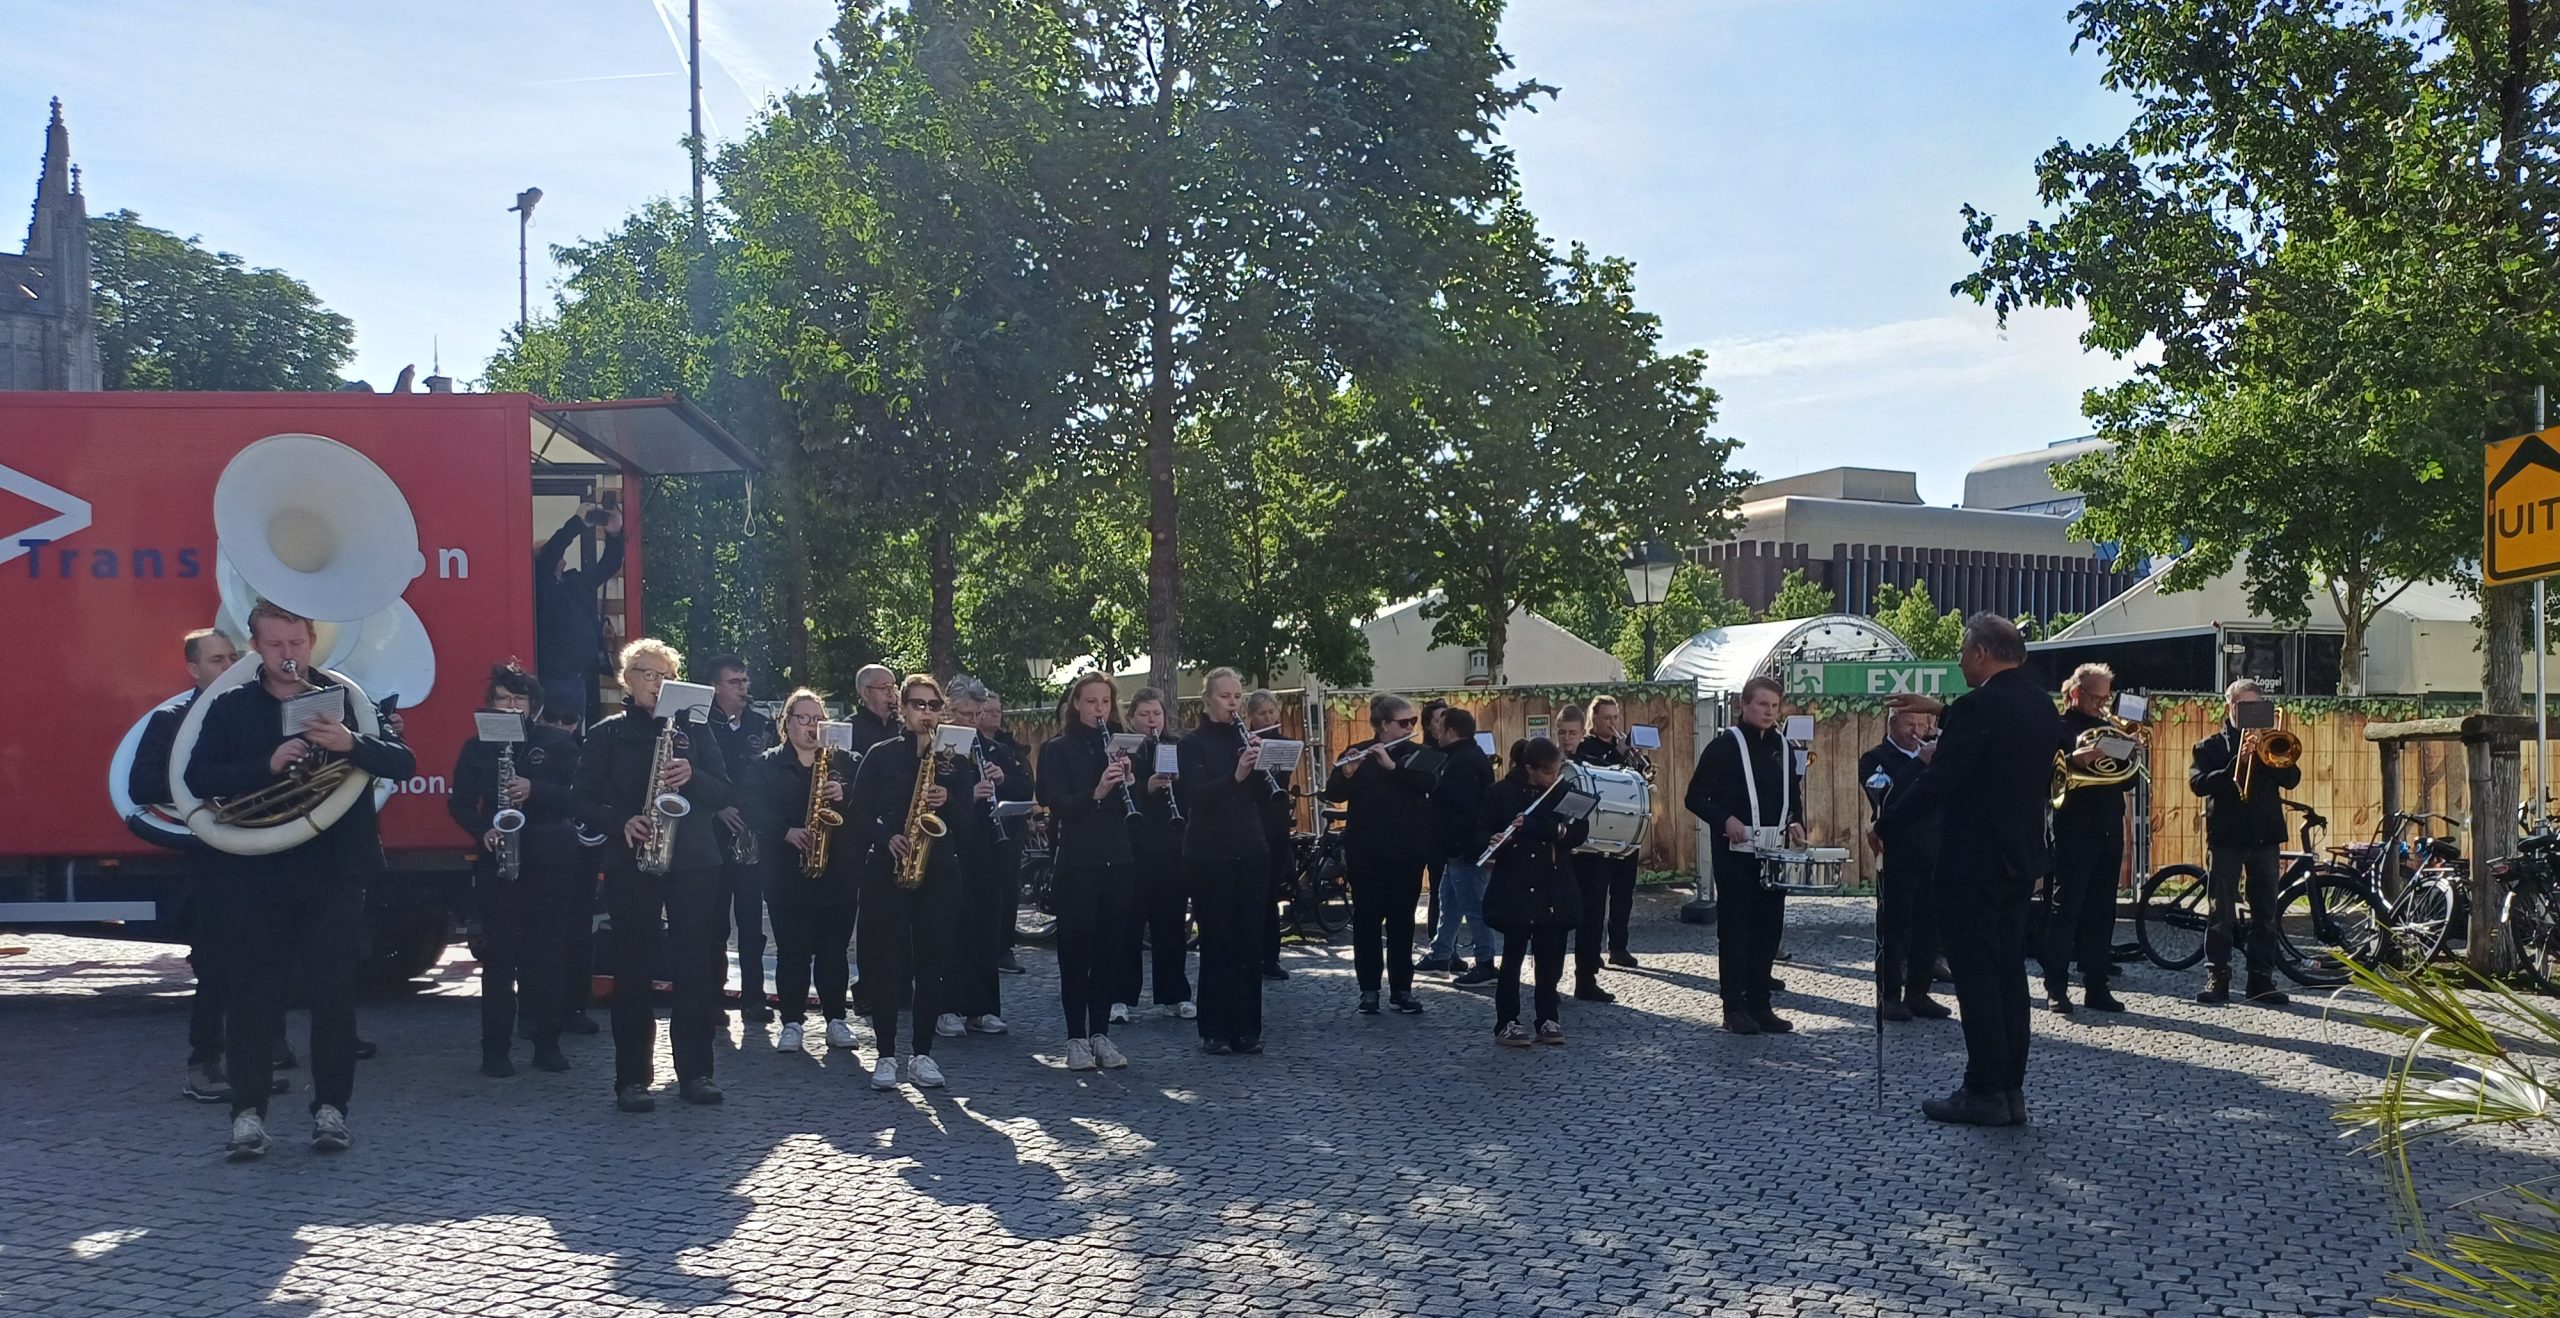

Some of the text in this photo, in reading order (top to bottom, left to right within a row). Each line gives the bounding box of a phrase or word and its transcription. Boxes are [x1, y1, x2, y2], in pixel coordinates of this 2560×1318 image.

[2498, 496, 2560, 539] UIT
[1867, 668, 1947, 694] EXIT
[2254, 675, 2282, 688] Zoggel
